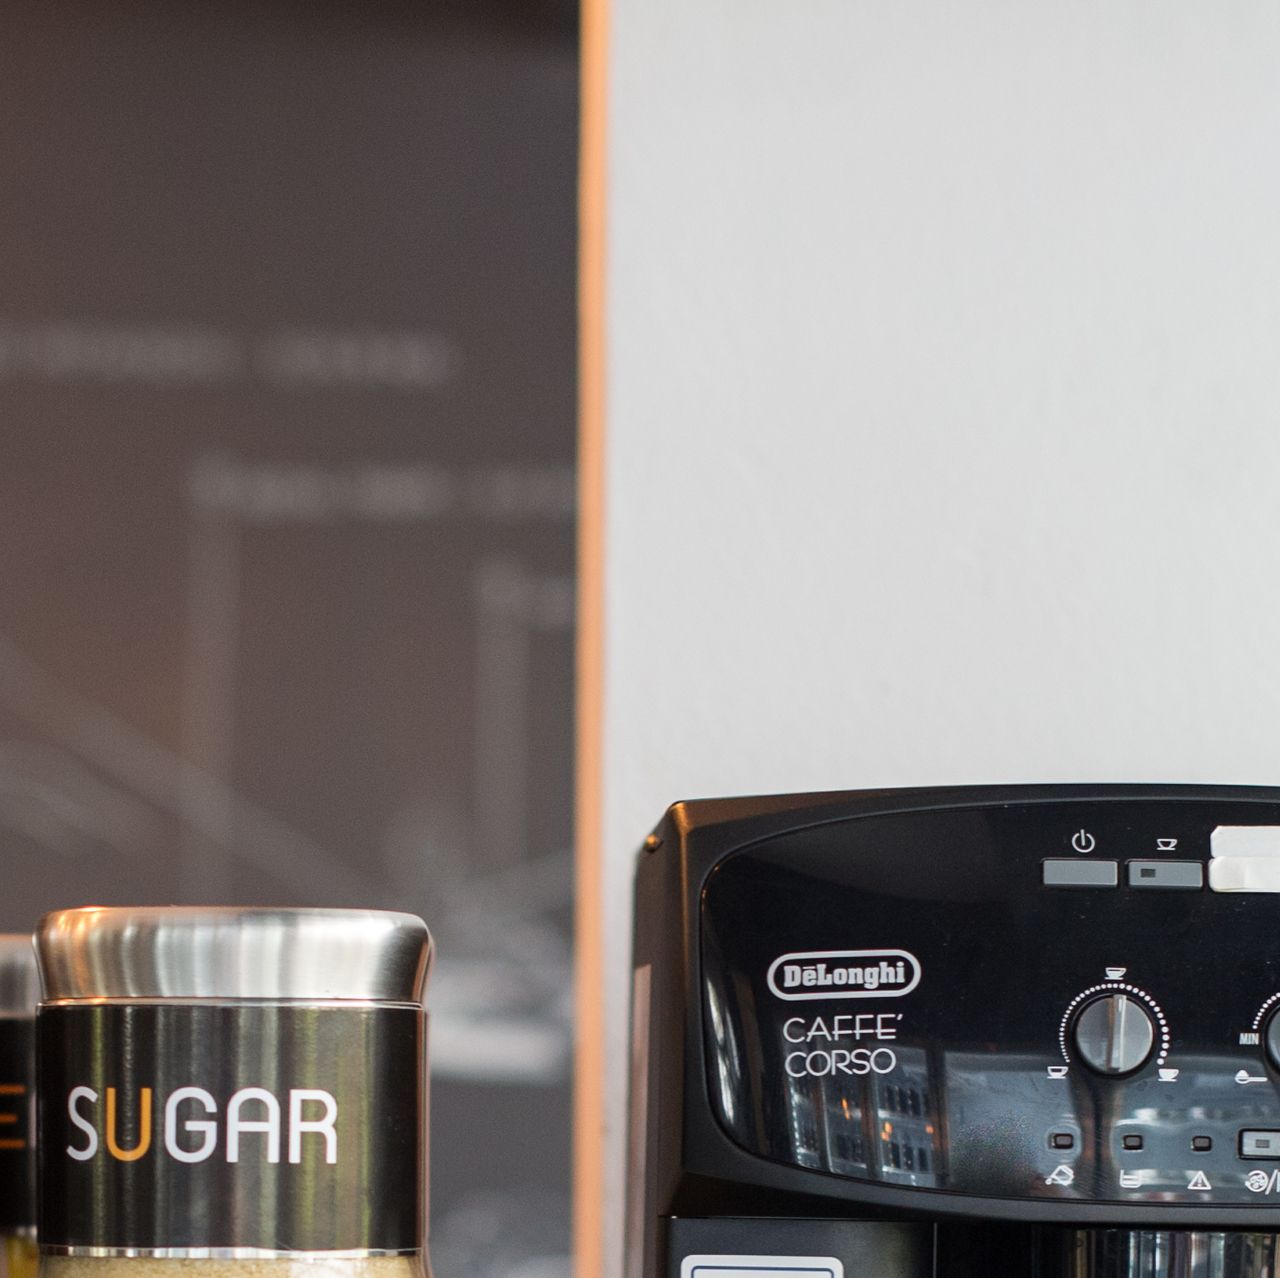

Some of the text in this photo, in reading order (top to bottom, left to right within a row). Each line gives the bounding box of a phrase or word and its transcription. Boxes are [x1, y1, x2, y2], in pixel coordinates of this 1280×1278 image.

[1239, 1032, 1259, 1045] MIN
[784, 1047, 897, 1077] CORSO
[67, 1086, 338, 1164] SUGAR
